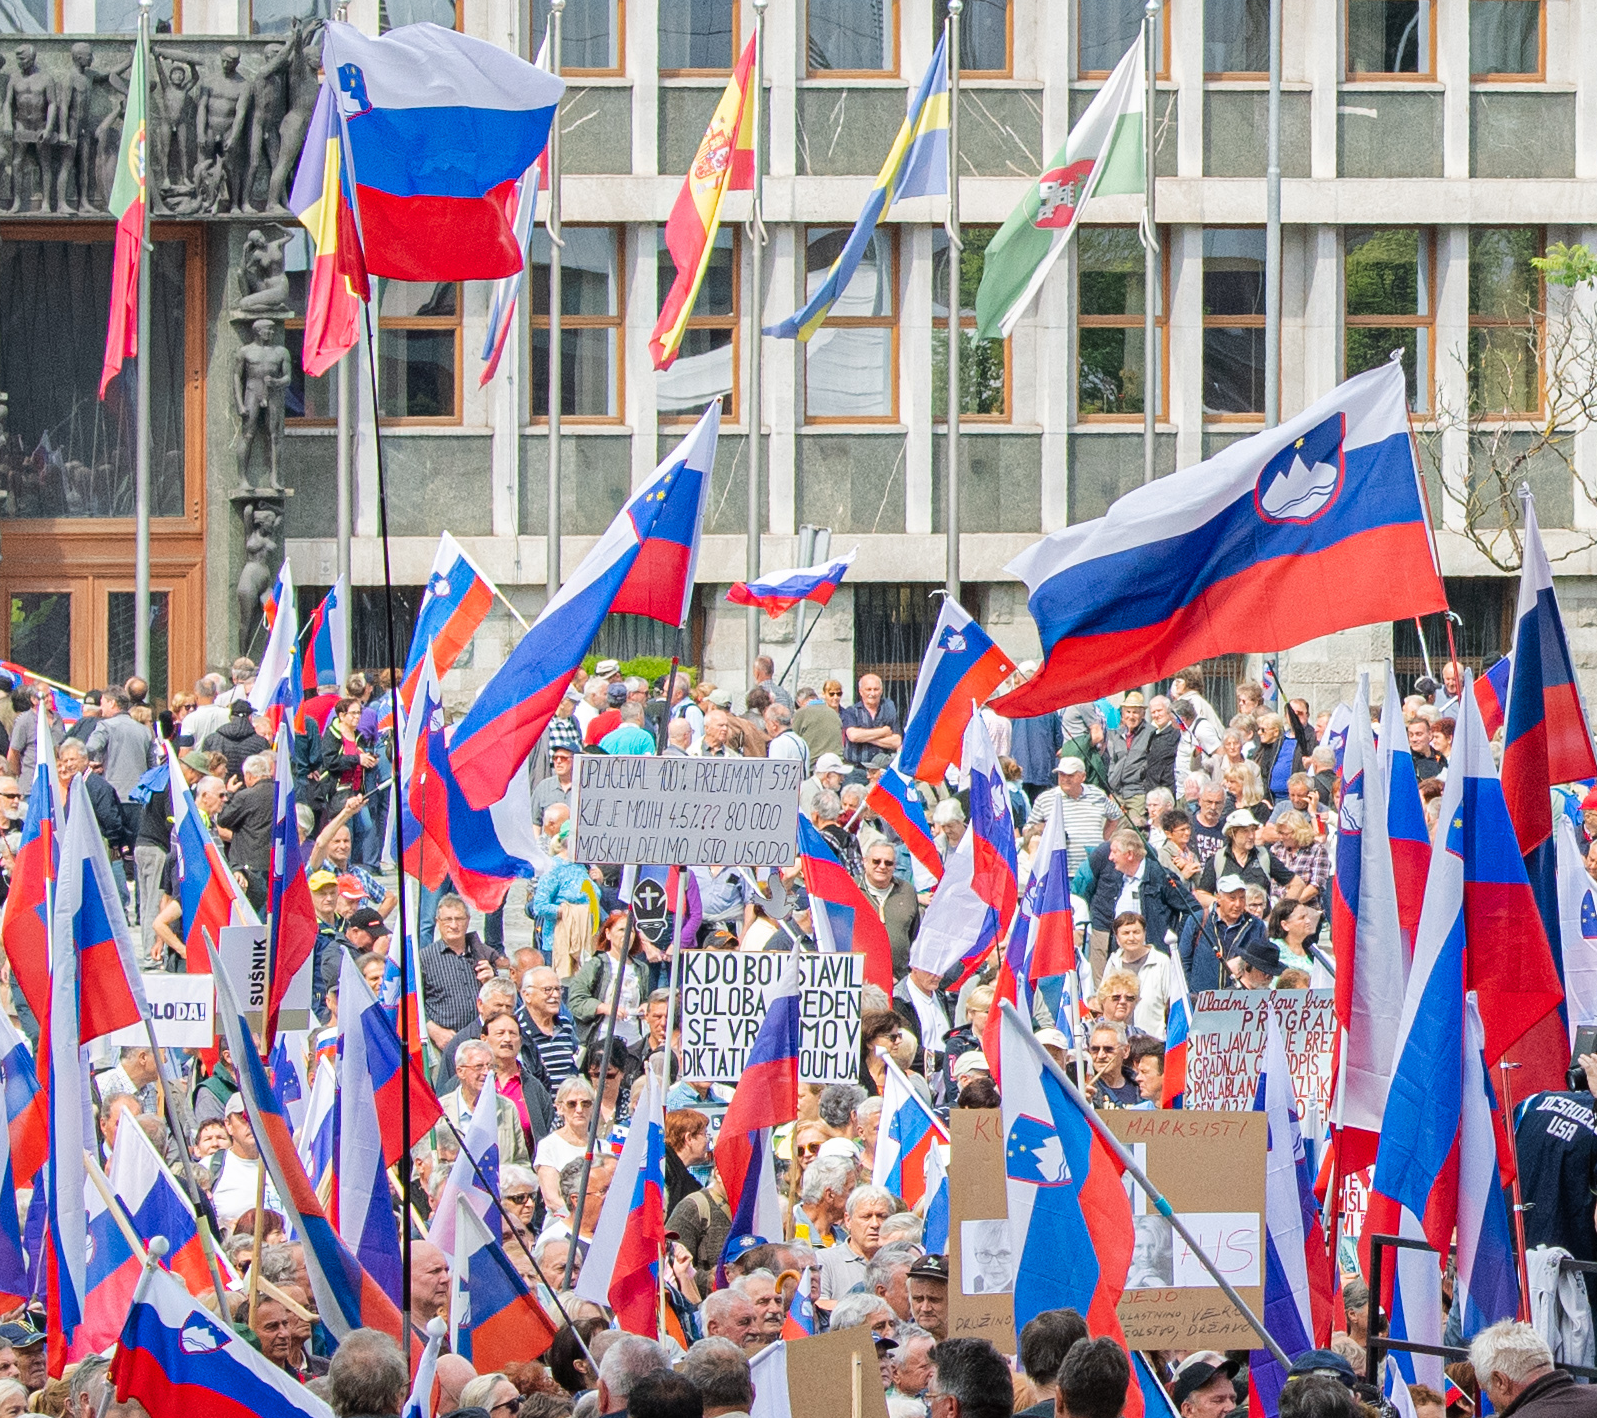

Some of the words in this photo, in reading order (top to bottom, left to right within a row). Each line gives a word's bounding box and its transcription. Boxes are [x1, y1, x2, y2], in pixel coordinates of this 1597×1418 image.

[693, 762, 765, 795] PREJEMAM
[579, 799, 606, 828] KJE
[577, 833, 631, 864] MOŠKIH
[635, 836, 689, 866] DELIMO
[733, 840, 791, 867] USODO
[248, 938, 268, 1007] SUŠNIK
[684, 952, 738, 986] KDO
[743, 954, 772, 986] BO
[684, 987, 767, 1017] GOLOBA
[688, 1018, 718, 1047] SE
[845, 1020, 860, 1049] V
[1125, 1117, 1250, 1138] MARKSISTI
[1546, 1115, 1579, 1142] USA
